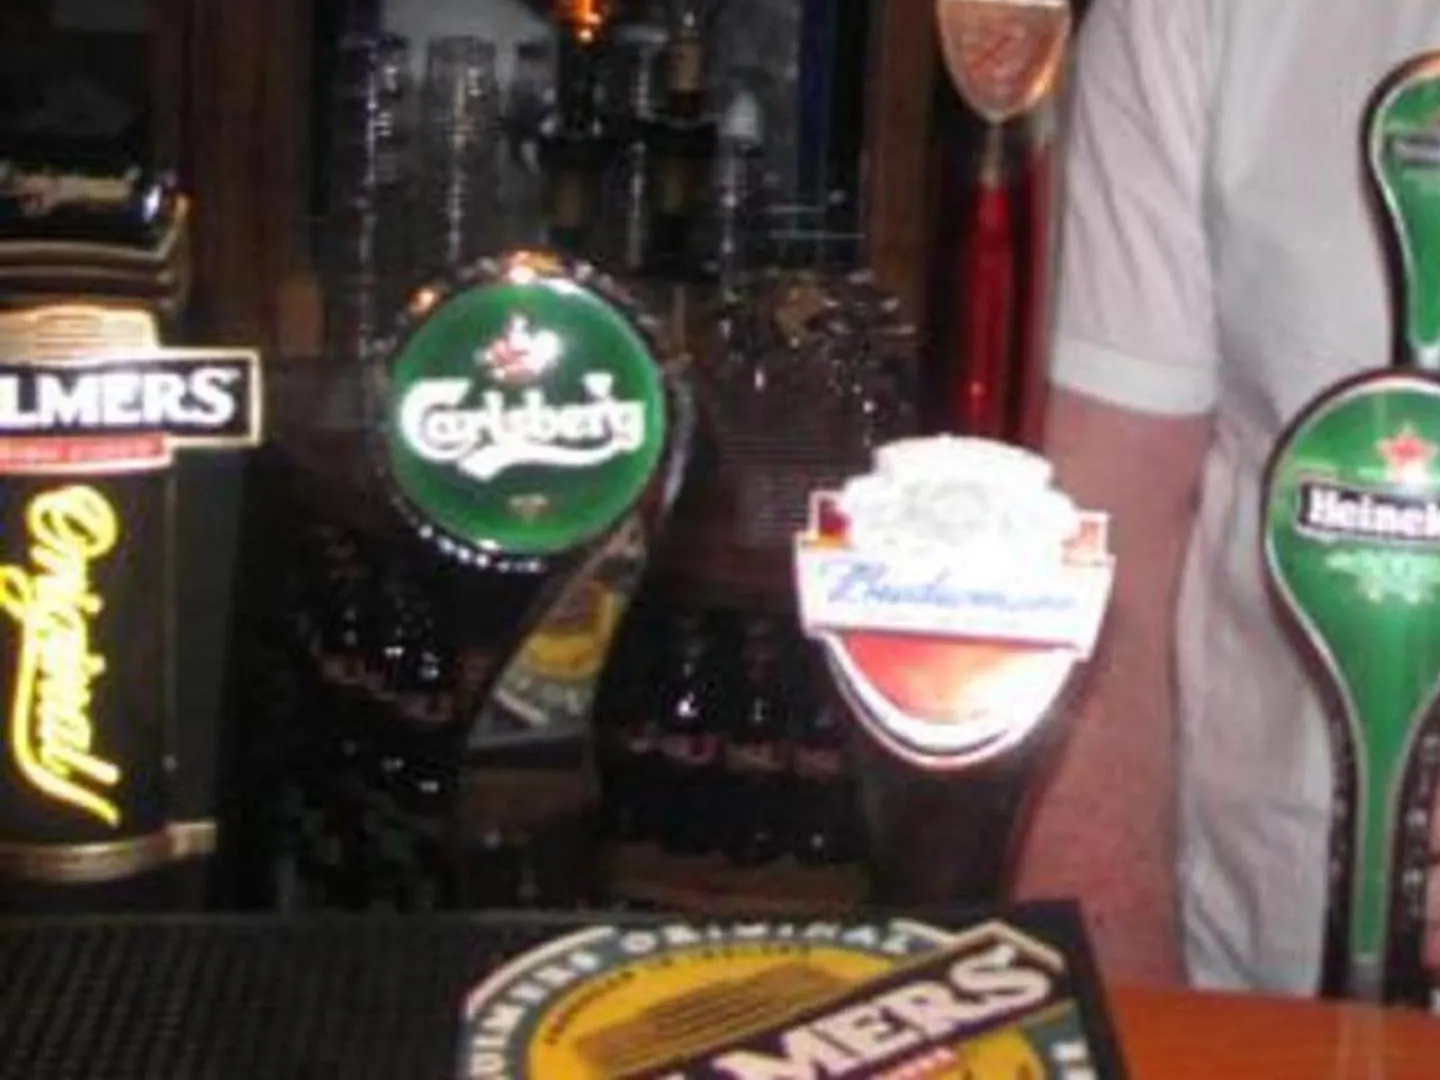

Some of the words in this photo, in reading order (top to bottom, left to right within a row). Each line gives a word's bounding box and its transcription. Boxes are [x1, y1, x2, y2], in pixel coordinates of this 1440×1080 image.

[398, 372, 646, 482] Carlsberg
[0, 484, 119, 826] Original
[467, 948, 601, 1080] ULMERS
[655, 941, 1052, 1080] MERS
